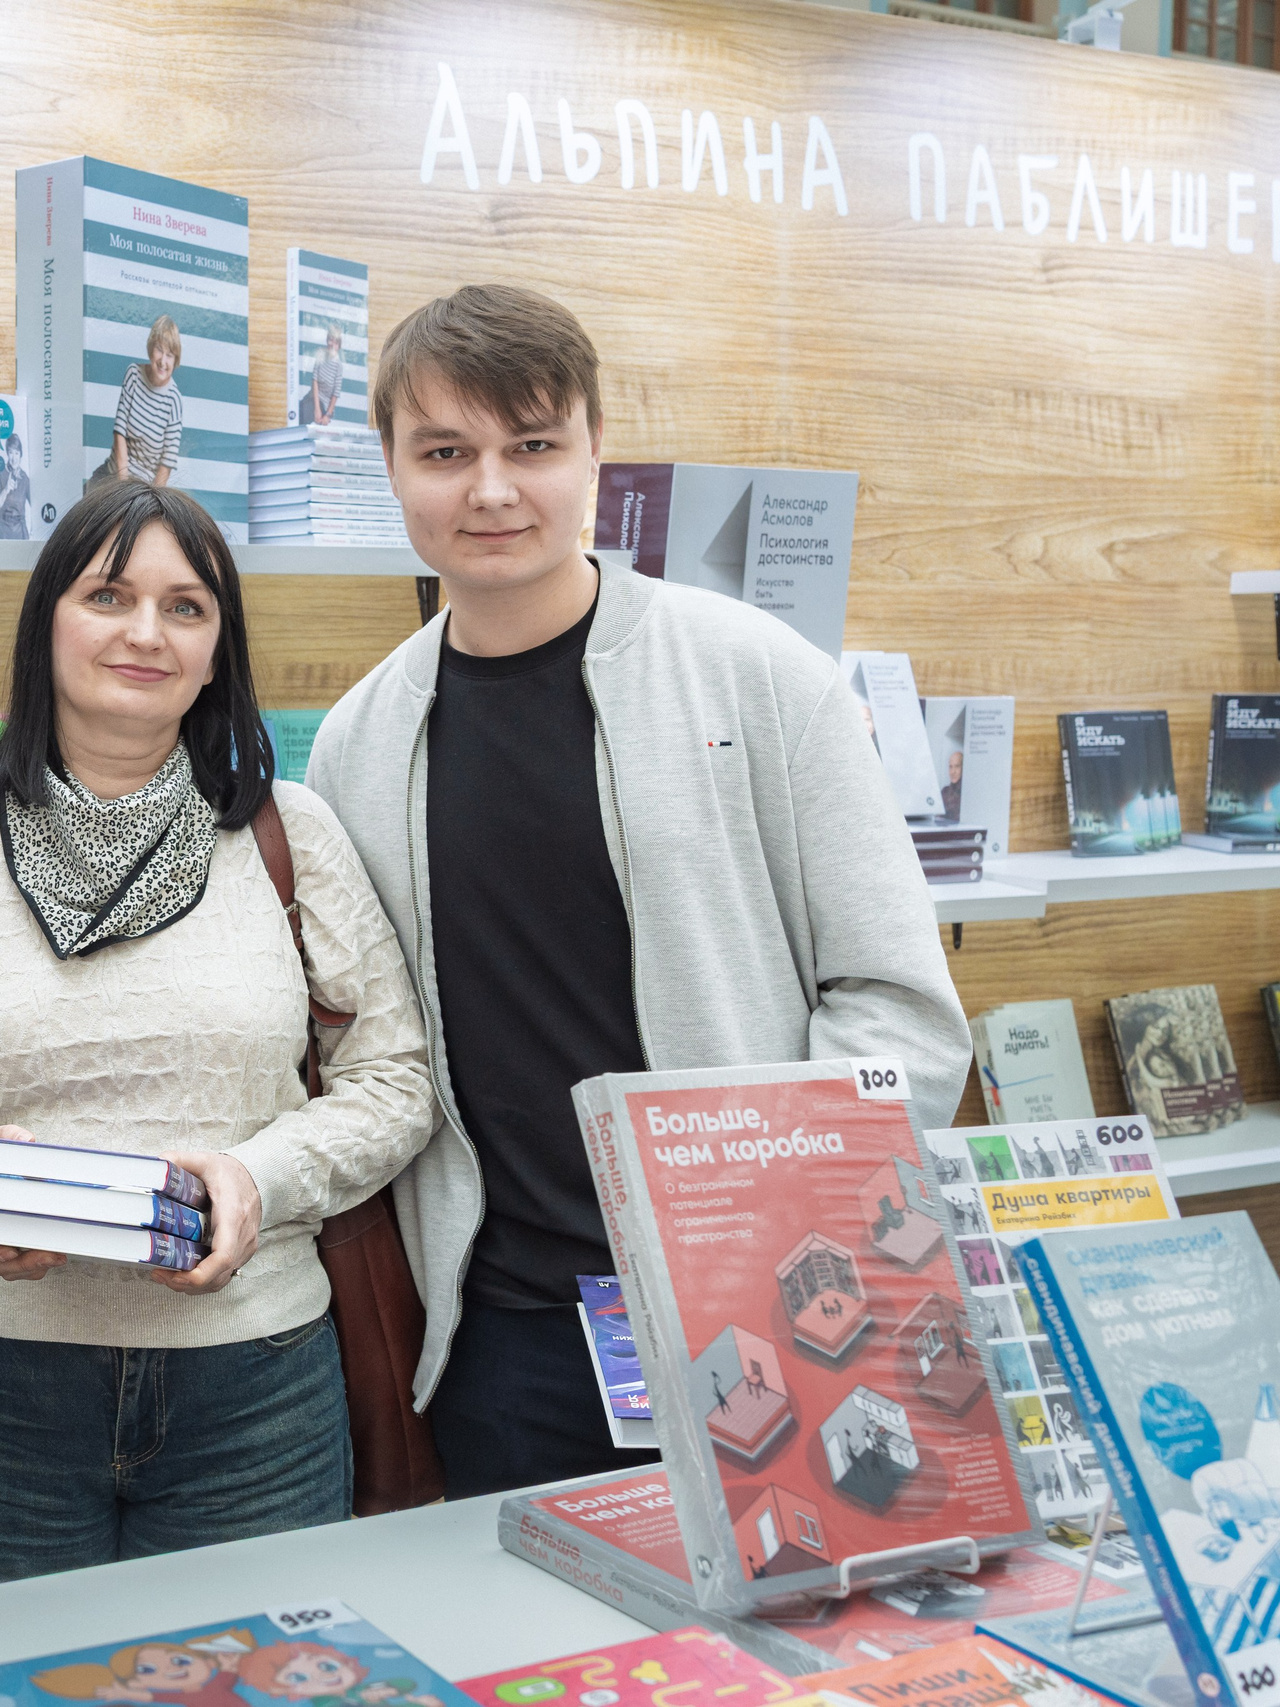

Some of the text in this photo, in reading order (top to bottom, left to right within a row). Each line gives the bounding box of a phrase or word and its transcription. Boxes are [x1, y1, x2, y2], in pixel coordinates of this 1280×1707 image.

[45, 206, 53, 247] Зверева
[132, 206, 208, 238] Нина Зверева
[109, 231, 229, 273] Моя полосатая жизнь
[120, 269, 150, 286] Рассказы
[43, 258, 55, 469] Моя полосатая жизнь
[762, 493, 829, 515] Александр
[632, 491, 646, 565] Александр
[761, 510, 814, 526] Асмолов
[760, 533, 829, 549] Психология
[757, 554, 834, 567] достоинства
[755, 589, 774, 598] быть
[756, 578, 795, 589] Искусство
[1227, 709, 1260, 719] ИДУ
[1076, 726, 1103, 736] ИДУ
[1077, 735, 1125, 746] ИСКАТЬ
[1008, 1028, 1039, 1040] Надо
[1004, 1036, 1049, 1055] думать!
[645, 1105, 770, 1137] Больше,
[1096, 1123, 1143, 1146] 600
[653, 1127, 845, 1168] чем коробка
[594, 1110, 628, 1213] Больше,
[665, 1176, 755, 1195] О безграничном
[586, 1117, 629, 1276] чем коробка
[669, 1196, 733, 1211] потенциале
[991, 1185, 1151, 1212] Душа квартиры
[674, 1210, 755, 1229] ограниченного
[996, 1214, 1041, 1225] Екатерина
[677, 1227, 754, 1246] пространства
[628, 1252, 647, 1311] Екатерина
[578, 1495, 675, 1524] чем ко
[519, 1514, 583, 1567] Больше,
[518, 1537, 624, 1603] чем коробка
[279, 1608, 332, 1628] 950
[847, 1668, 991, 1701] Пиши,
